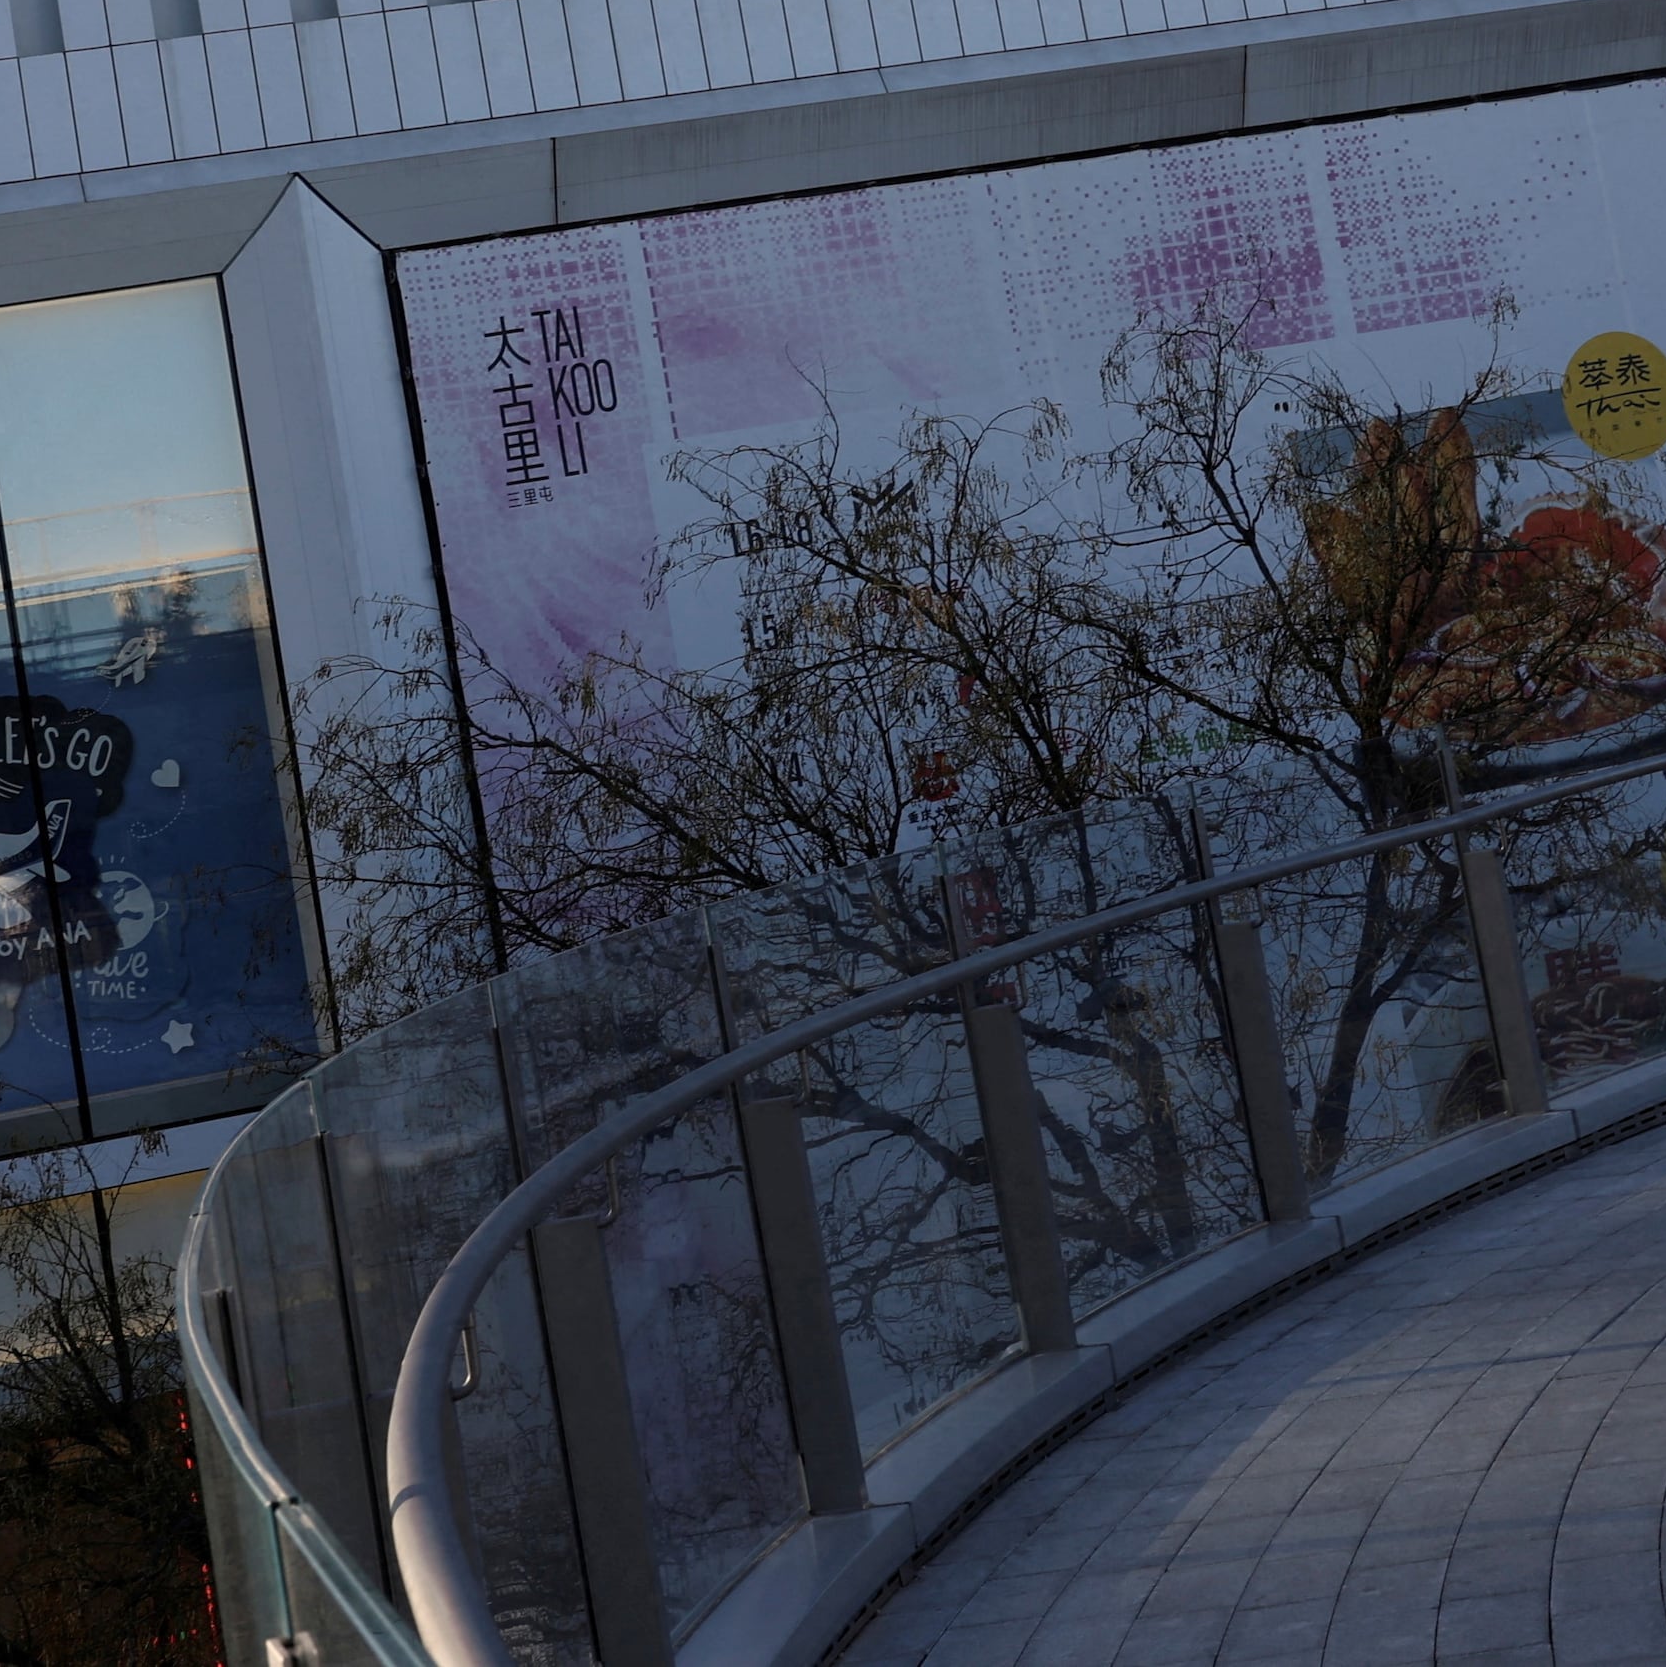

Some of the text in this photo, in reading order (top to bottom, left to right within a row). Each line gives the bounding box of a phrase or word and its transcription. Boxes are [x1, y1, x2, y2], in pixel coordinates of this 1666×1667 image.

[531, 306, 584, 363] TAI
[548, 359, 617, 420] KOO
[557, 422, 588, 477] LI
[508, 485, 554, 509] 三里屯
[66, 727, 113, 777] GO
[87, 980, 137, 1000] TIME
